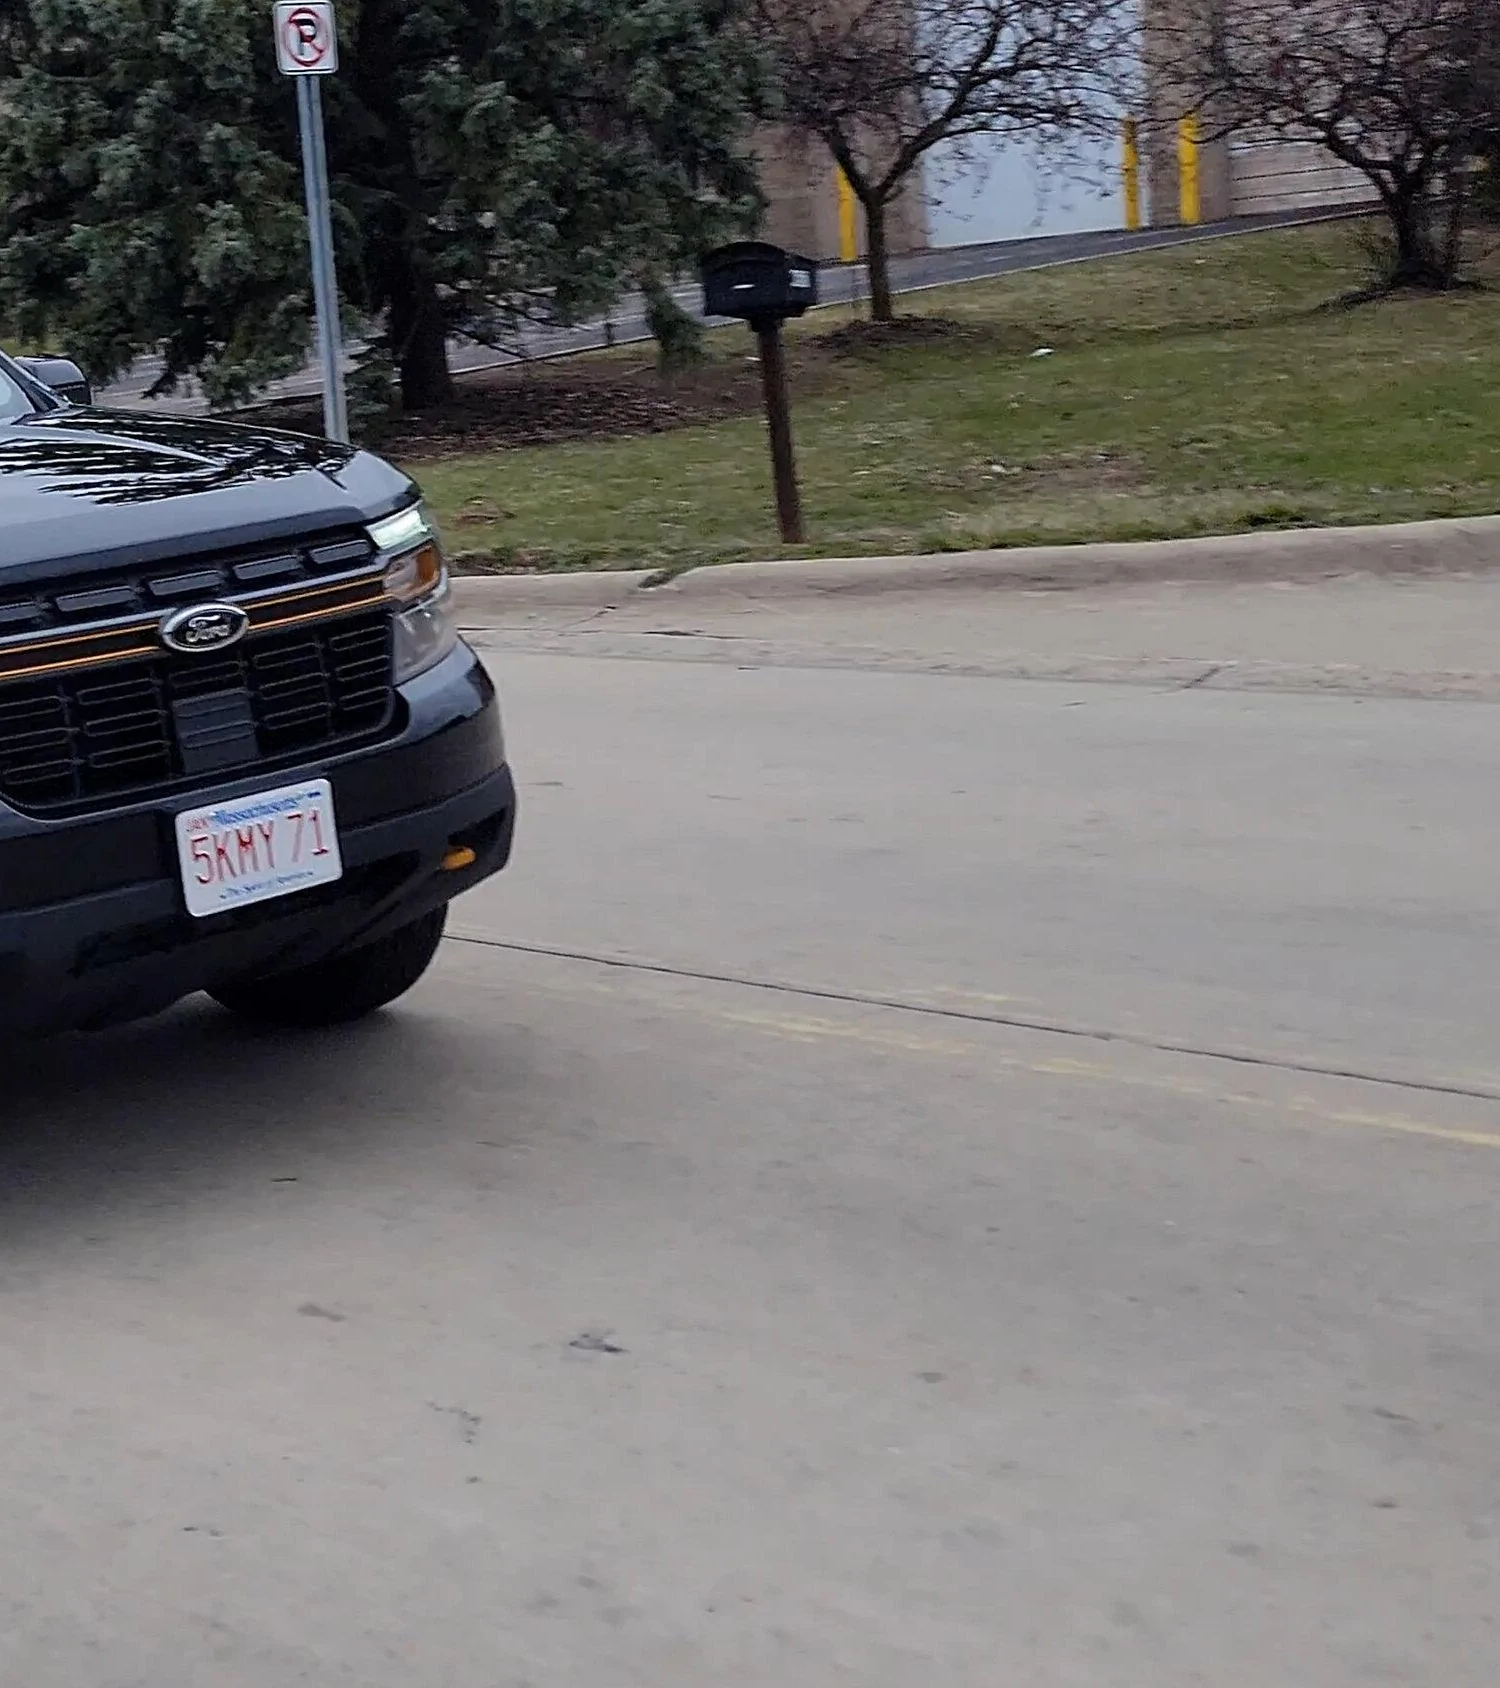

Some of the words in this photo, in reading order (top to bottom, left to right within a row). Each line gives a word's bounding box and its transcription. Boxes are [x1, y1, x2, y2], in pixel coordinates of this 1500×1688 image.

[296, 18, 317, 56] P
[185, 613, 231, 643] Ford
[190, 820, 275, 884] 5KMY
[287, 809, 330, 863] 71
